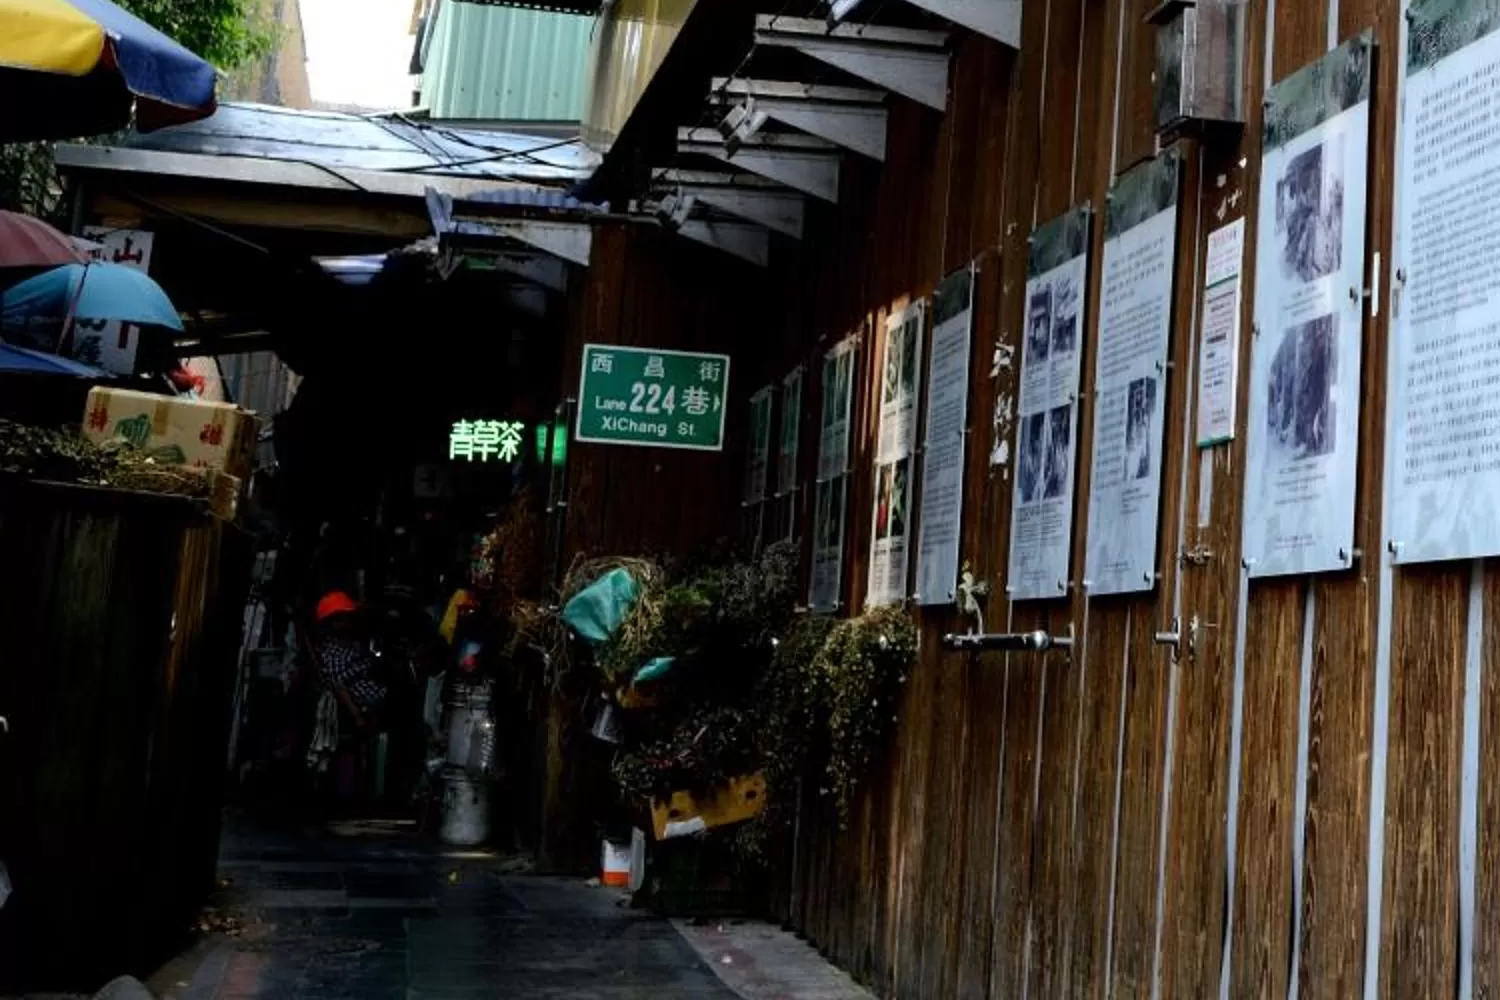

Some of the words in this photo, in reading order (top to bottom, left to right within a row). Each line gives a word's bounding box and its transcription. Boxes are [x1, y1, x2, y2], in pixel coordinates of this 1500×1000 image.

[591, 353, 721, 382] 西昌街
[595, 396, 627, 411] Lane
[629, 381, 676, 416] 224
[449, 418, 525, 462] 青草茶
[601, 415, 668, 438] XiChang
